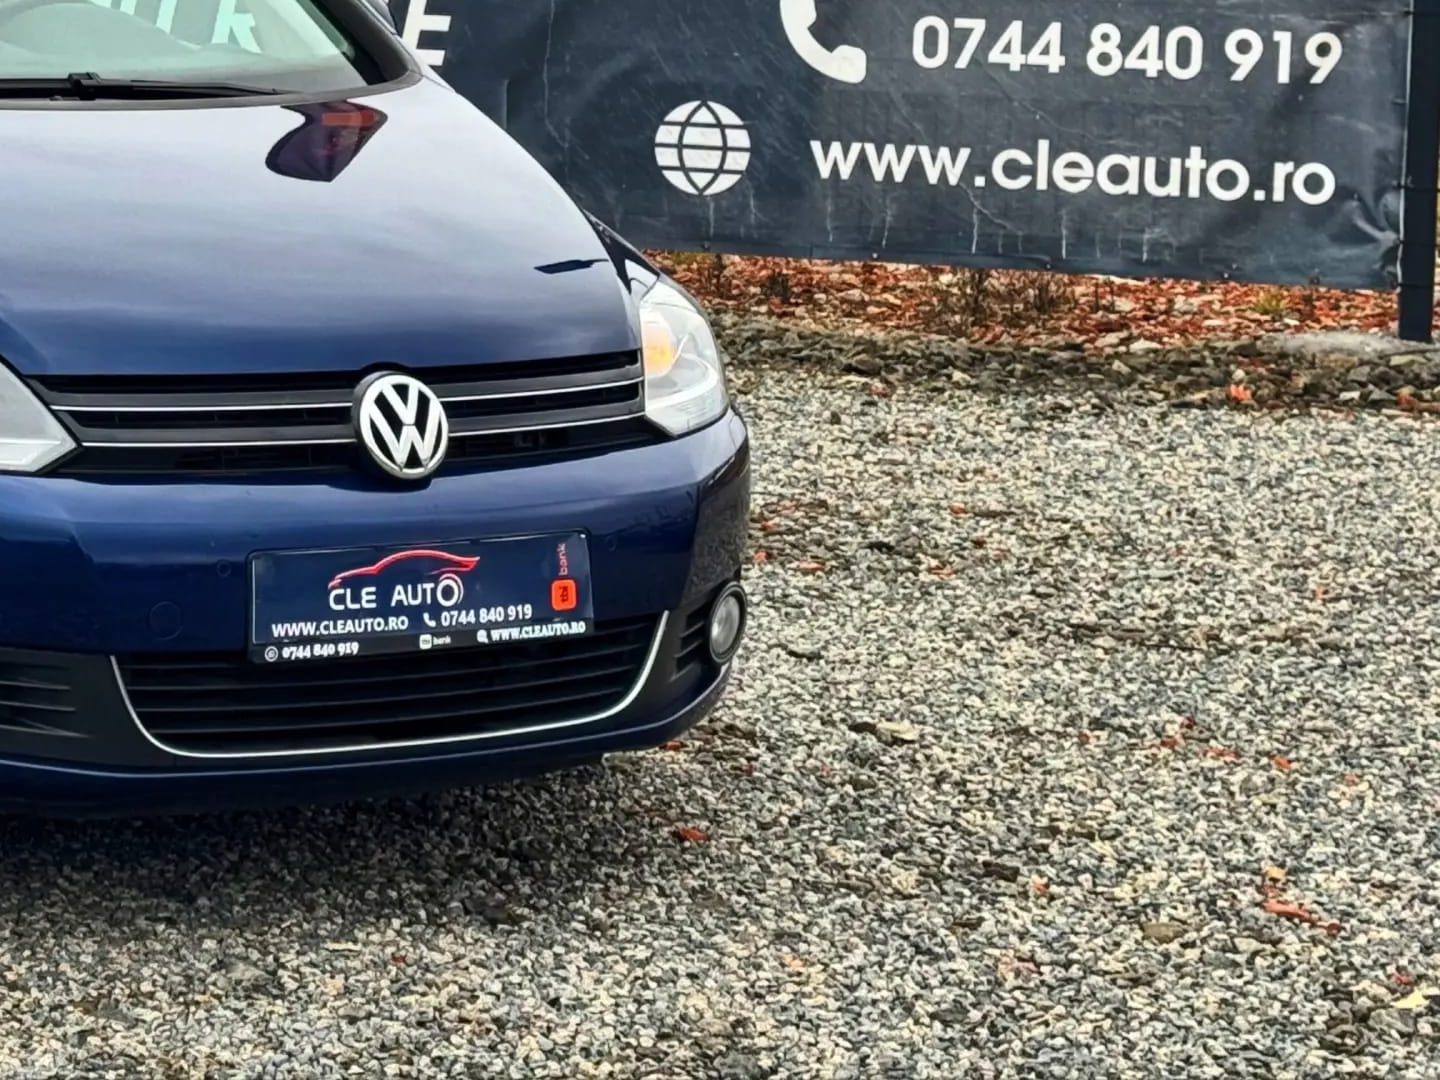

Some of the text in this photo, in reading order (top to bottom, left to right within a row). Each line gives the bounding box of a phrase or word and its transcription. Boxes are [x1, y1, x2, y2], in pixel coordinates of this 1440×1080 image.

[913, 15, 1344, 84] 0744 840 919
[810, 139, 1336, 206] www.cleauto.ro
[329, 578, 459, 610] CLE AUTO
[272, 616, 409, 638] WWW.CLEAUTO.RO
[441, 604, 533, 627] 0744 840 919
[490, 621, 587, 642] WWW.CLEAUTO.RO
[282, 641, 359, 660] 0744 840 919
